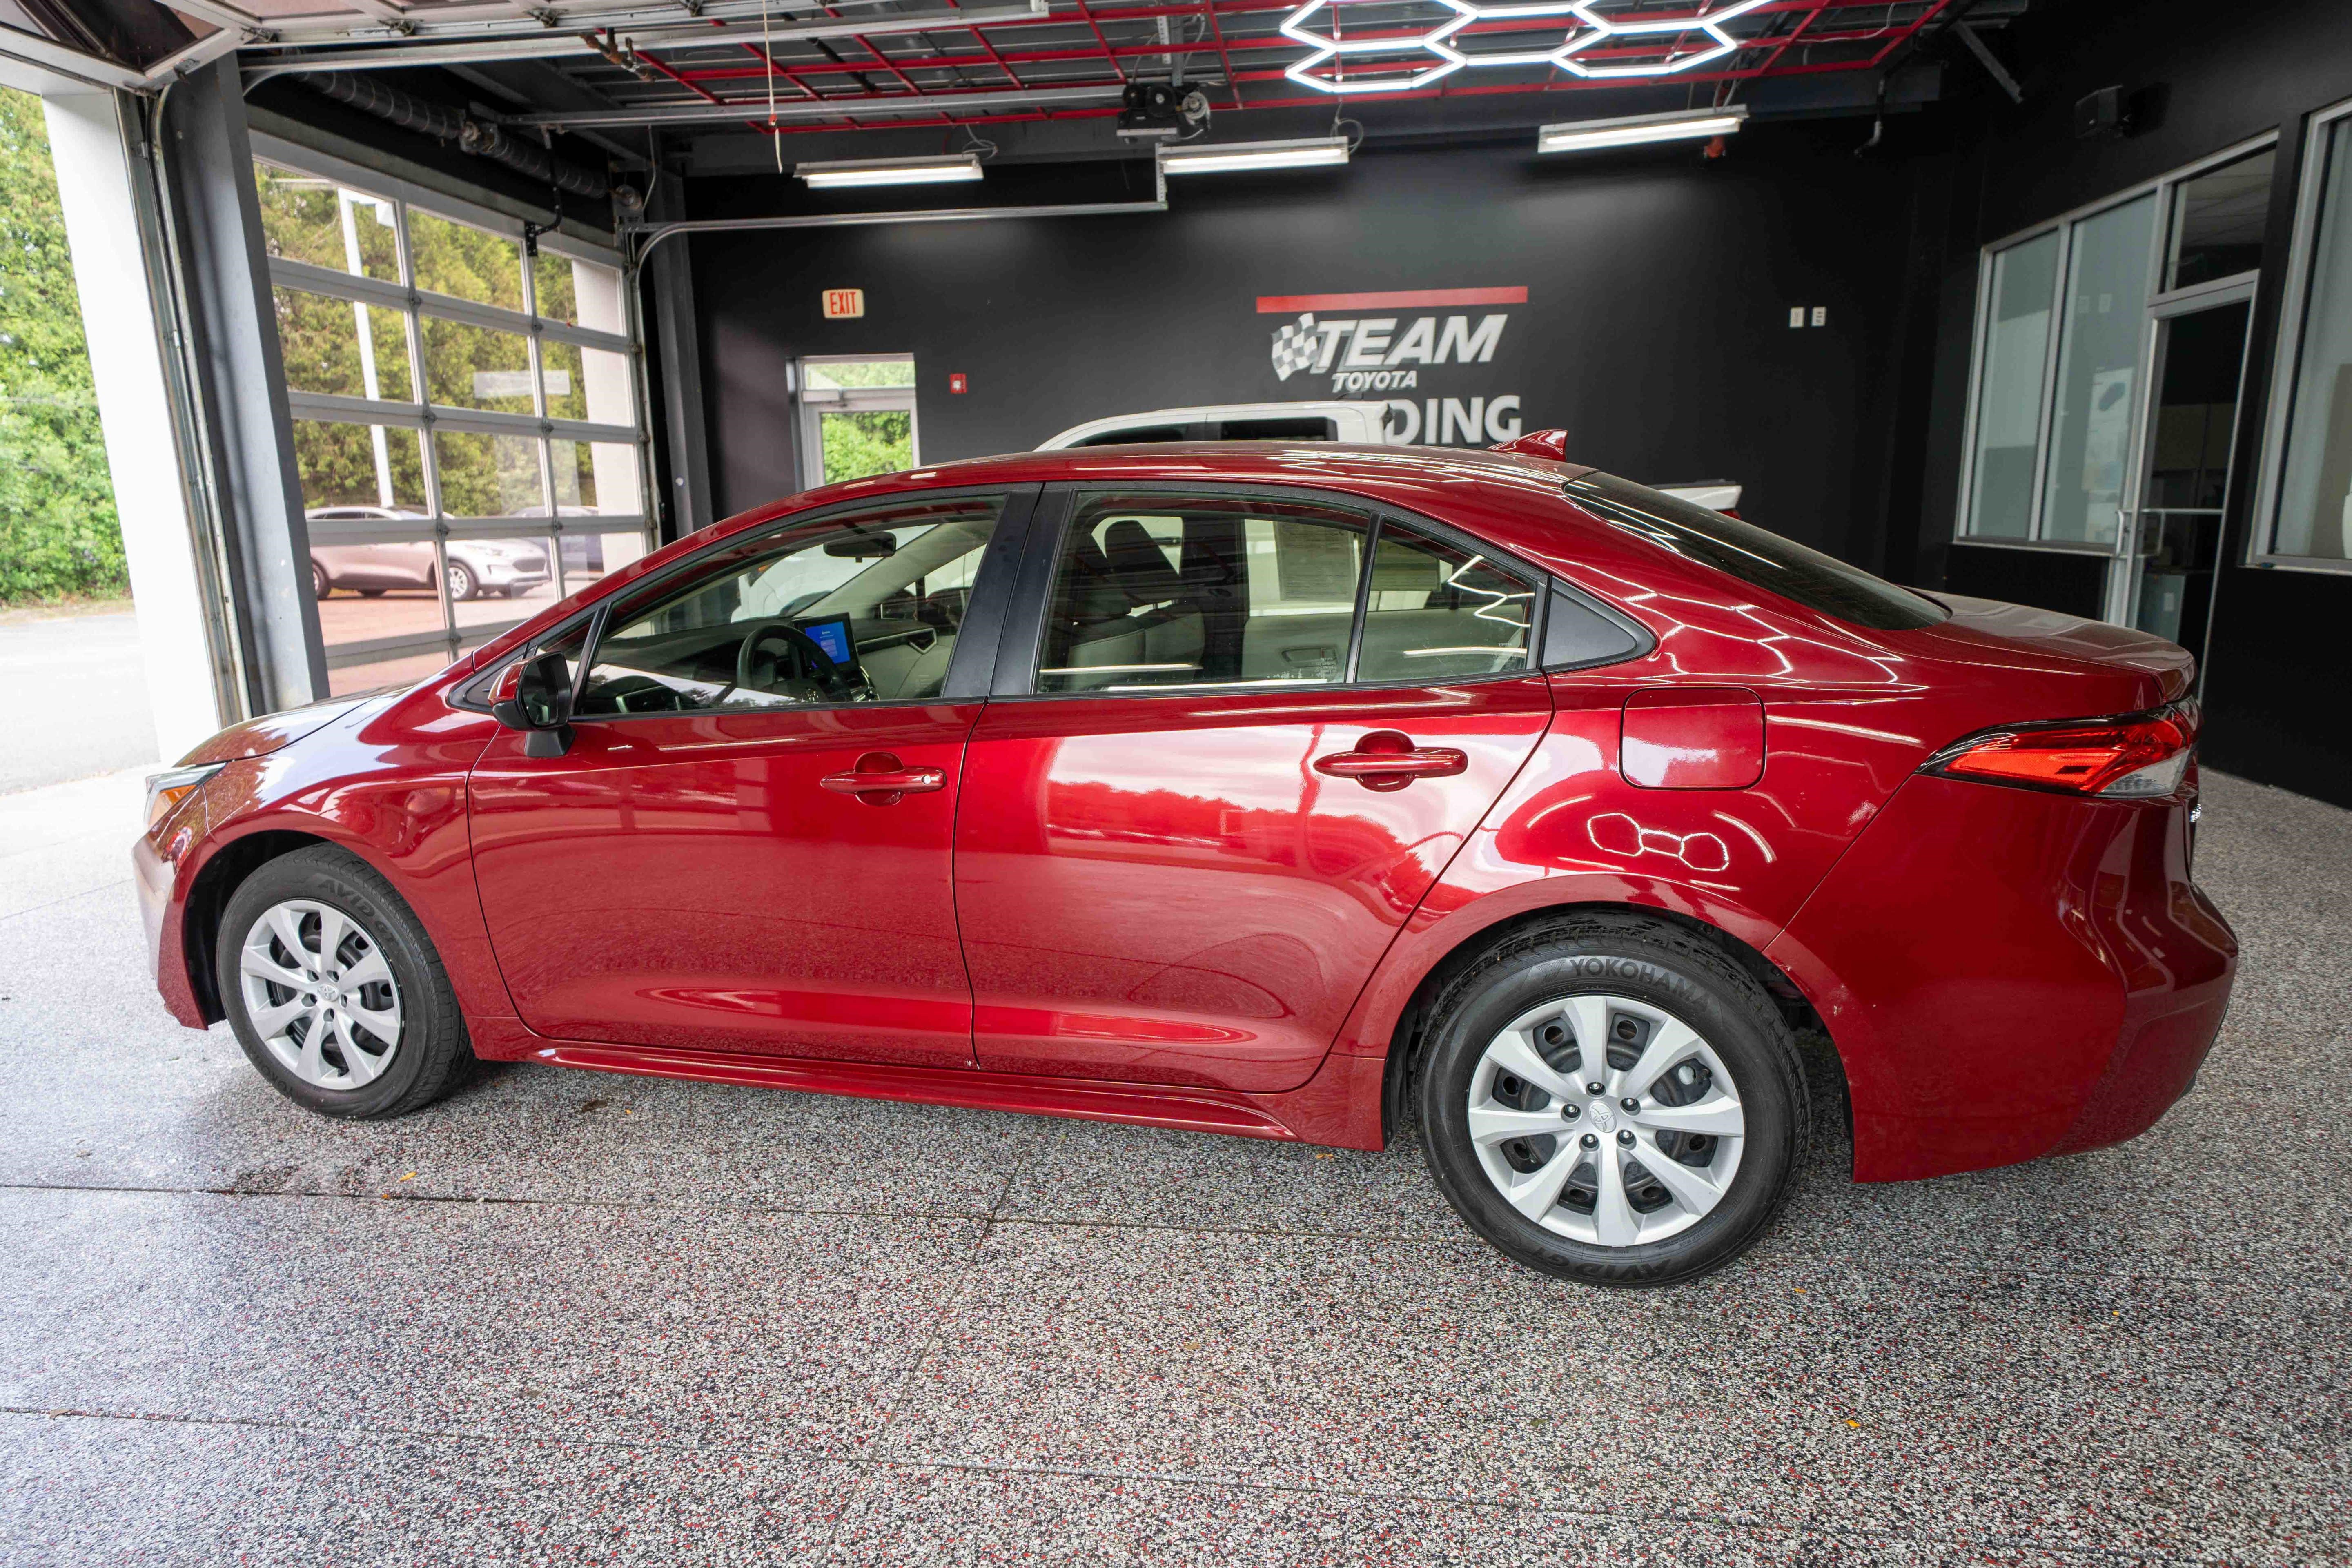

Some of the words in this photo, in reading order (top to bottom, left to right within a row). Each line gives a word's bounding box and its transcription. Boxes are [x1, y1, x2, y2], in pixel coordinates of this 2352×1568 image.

[830, 292, 856, 314] EXIT
[1311, 314, 1508, 372] TEAM
[1332, 370, 1417, 392] TOYOTA
[318, 880, 375, 917] AVID
[1570, 958, 1710, 1013] YOKOHAMA
[1575, 1260, 1670, 1279] AVID
